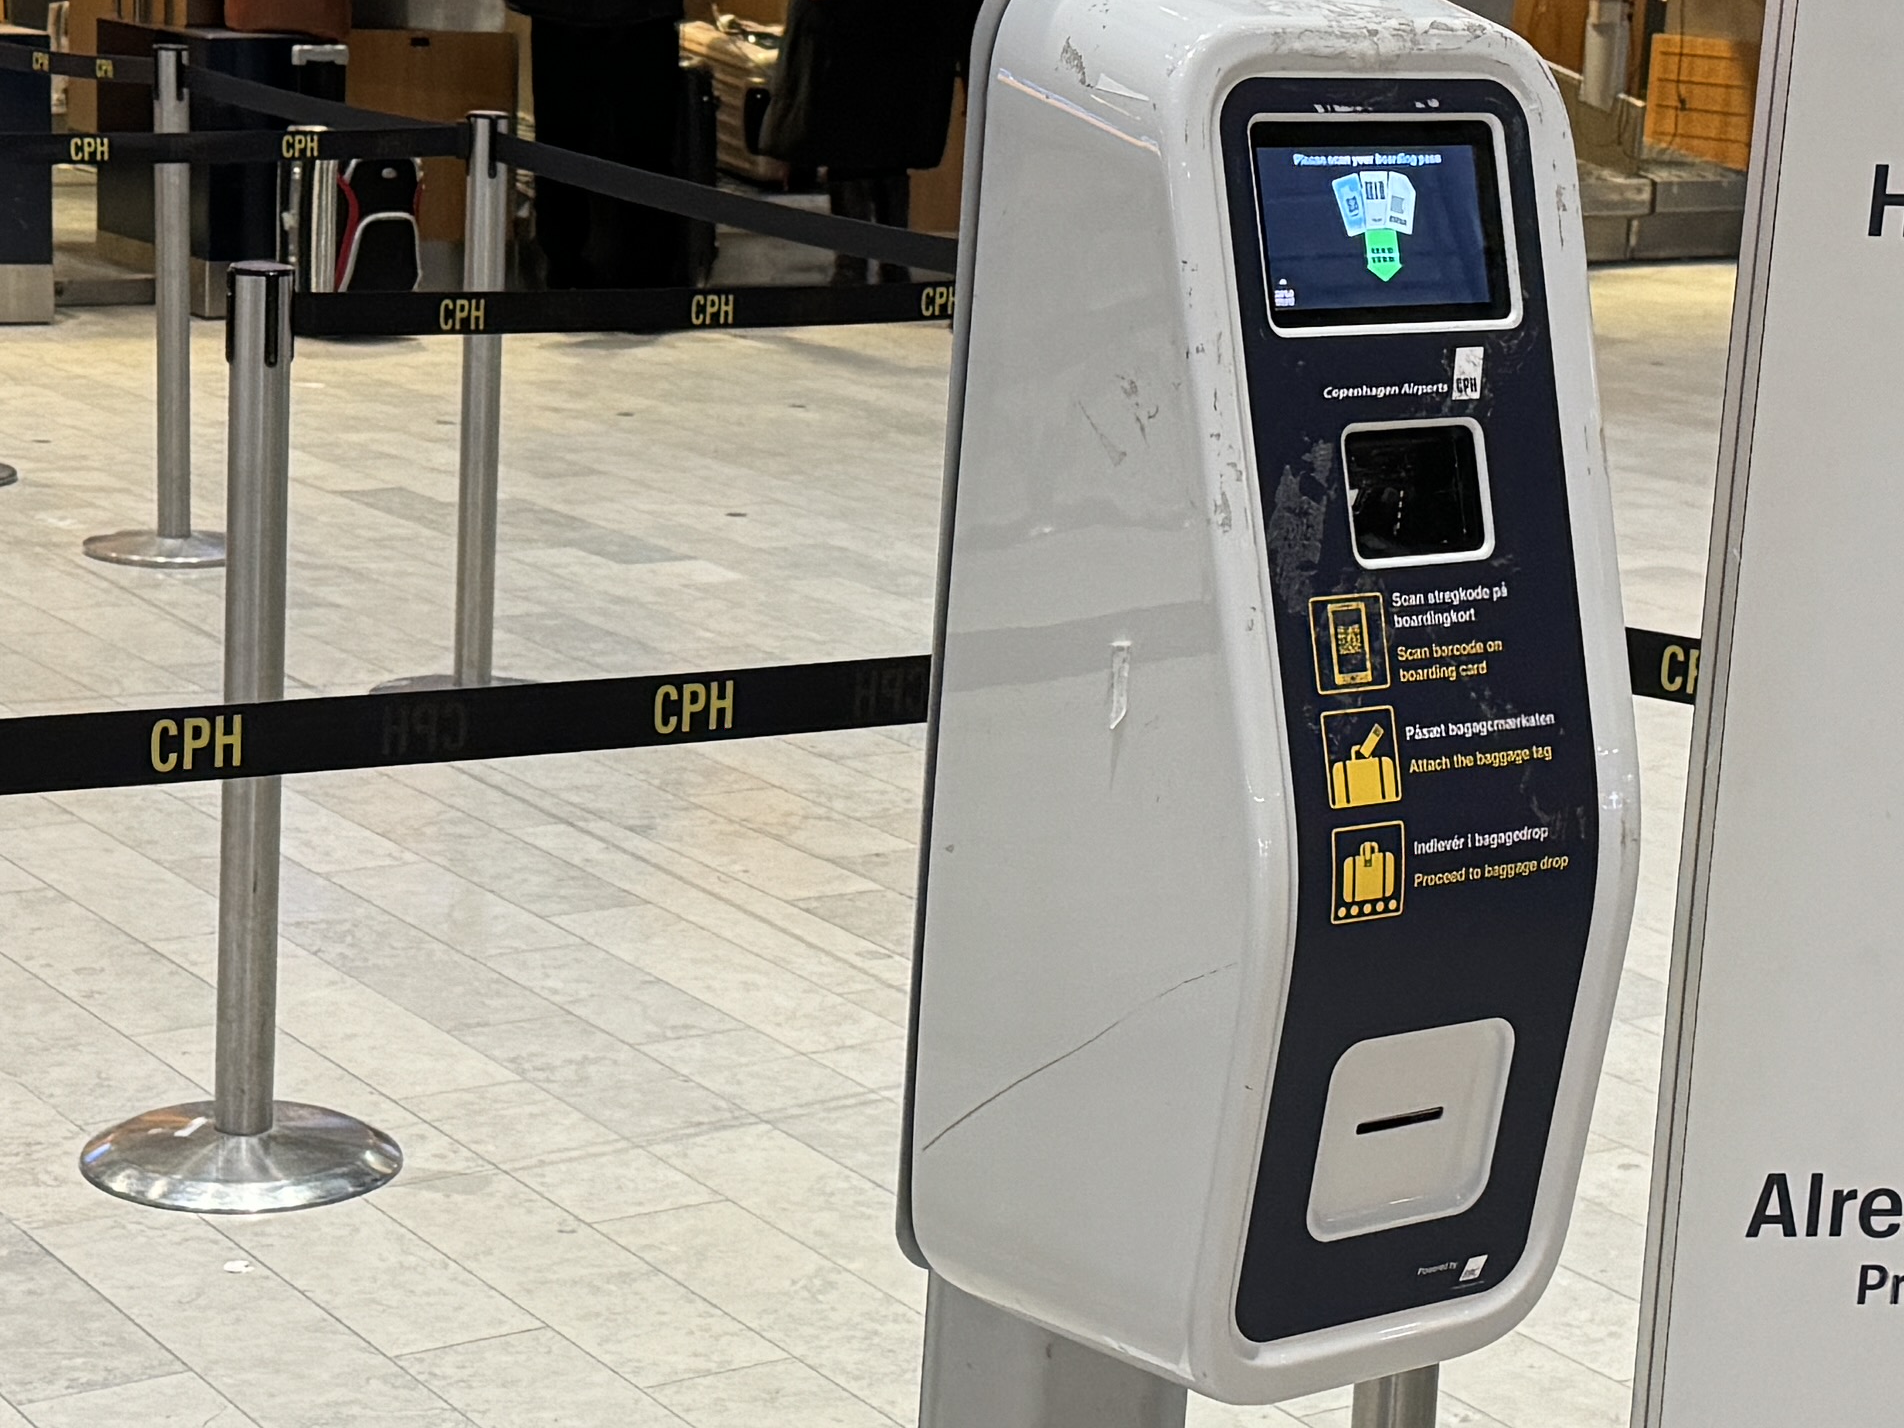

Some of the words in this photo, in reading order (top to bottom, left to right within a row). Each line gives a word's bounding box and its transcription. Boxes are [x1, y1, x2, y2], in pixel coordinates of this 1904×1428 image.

[69, 137, 109, 162] CPH
[281, 133, 319, 159] CPH
[439, 299, 485, 331] CPH
[691, 295, 734, 326] CPH
[1323, 383, 1399, 400] Copenhagen
[1487, 638, 1503, 652] on
[652, 680, 735, 736] CPH
[150, 714, 244, 773] CPH
[1409, 754, 1451, 775] Attach
[1453, 751, 1475, 770] the
[1476, 746, 1530, 769] baggage
[1413, 868, 1466, 889] Proceed
[1468, 865, 1482, 882] to
[1484, 858, 1539, 880] baggage
[1540, 854, 1569, 872] drop
